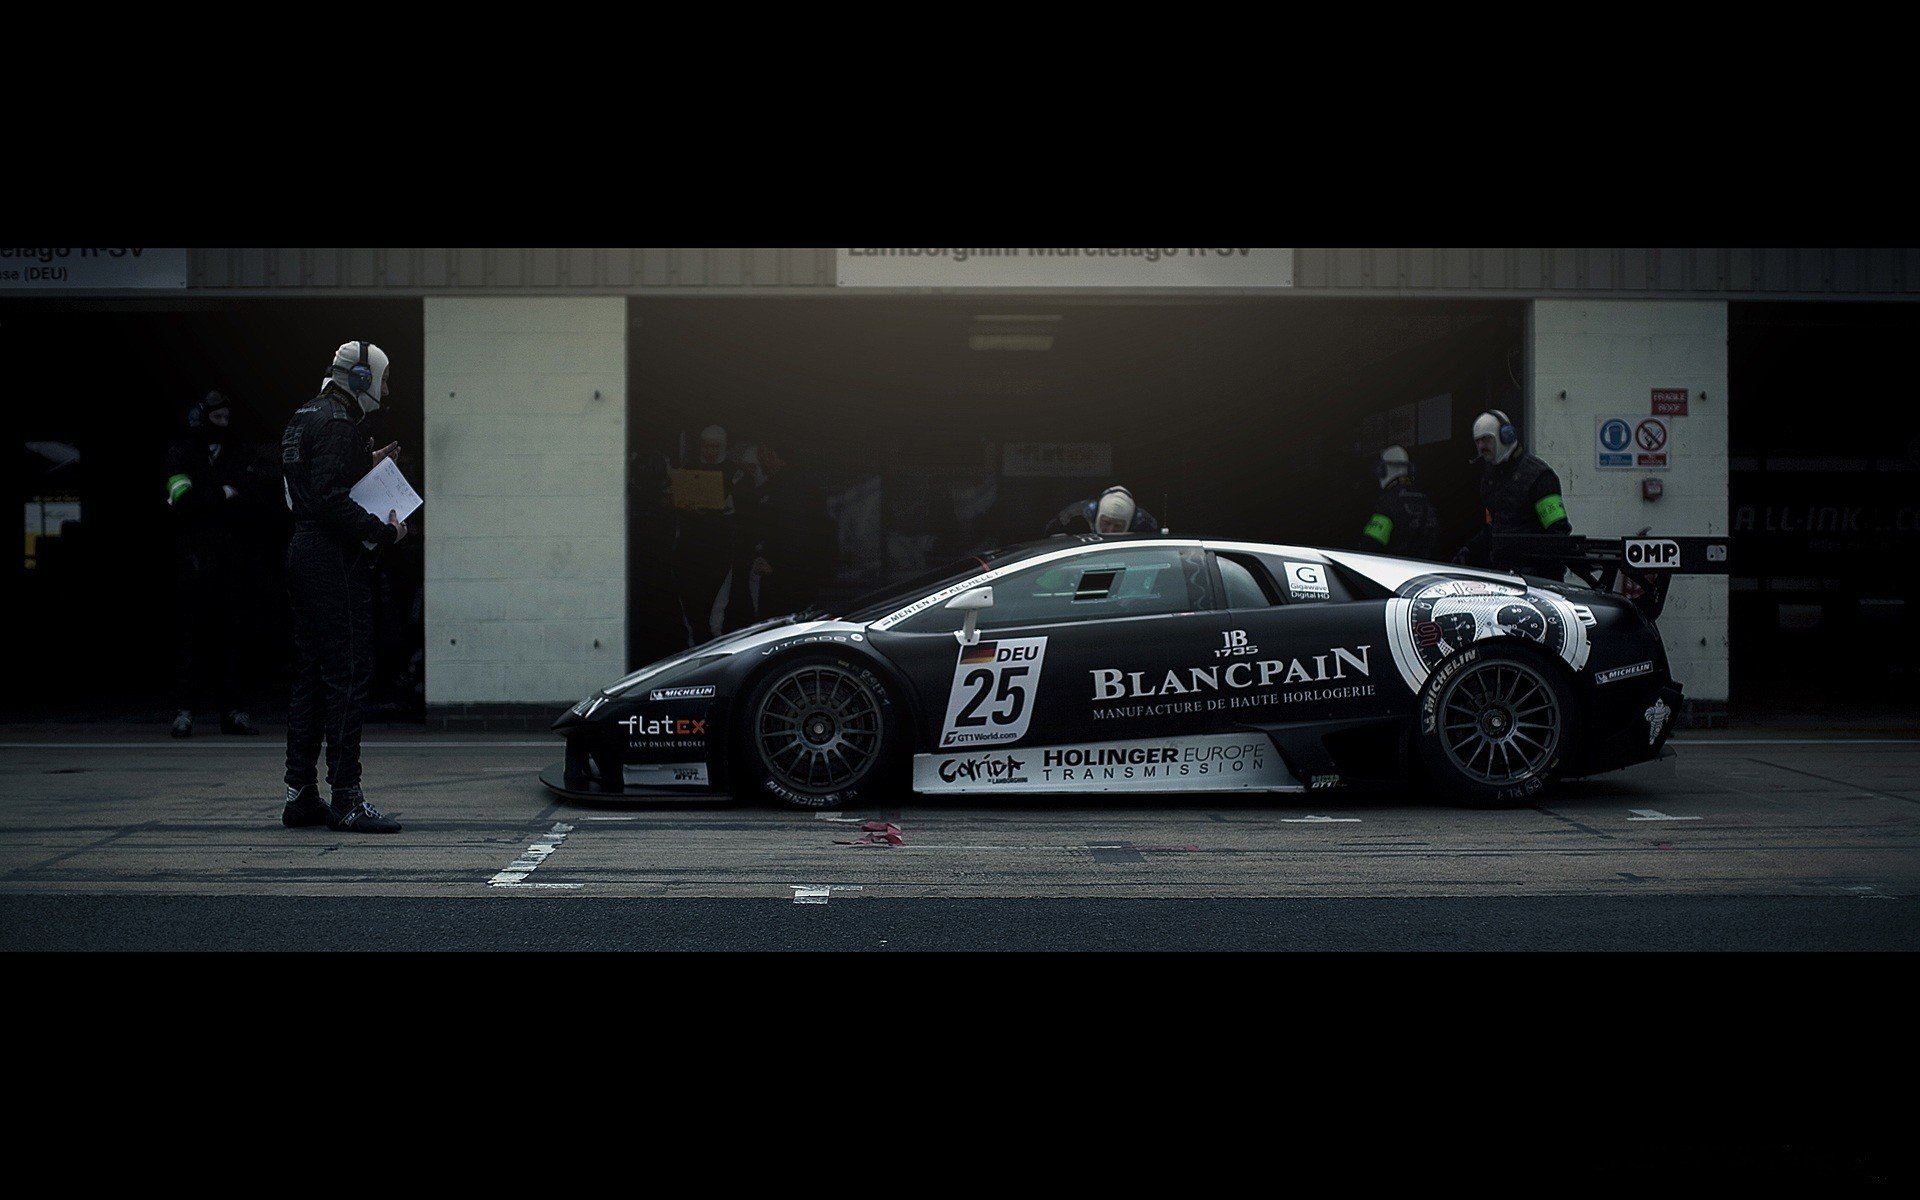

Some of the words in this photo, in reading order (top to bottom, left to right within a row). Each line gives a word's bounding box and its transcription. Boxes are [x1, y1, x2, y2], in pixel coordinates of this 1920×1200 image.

[24, 267, 68, 281] (DEU)
[1627, 543, 1678, 563] OMP
[1295, 566, 1318, 583] G
[1291, 591, 1317, 599] Digital
[996, 646, 1039, 663] DEU
[1089, 644, 1371, 701] BLANCPAIN
[1608, 663, 1651, 679] MICHELIN
[1424, 649, 1478, 713] MICHELIN
[664, 686, 713, 698] MICHELIN
[954, 666, 1031, 728] 25
[1093, 701, 1203, 721] MANUFACTURE
[1207, 698, 1226, 712] DE
[1230, 694, 1279, 709] HAUTE
[1283, 683, 1377, 704] HORLOGERIE
[629, 740, 649, 749] EASY
[649, 740, 677, 749] ONLINE
[1043, 747, 1180, 767] HOLINGER
[1183, 743, 1266, 763] EUROPE
[1043, 759, 1264, 781] TRANSMISSION
